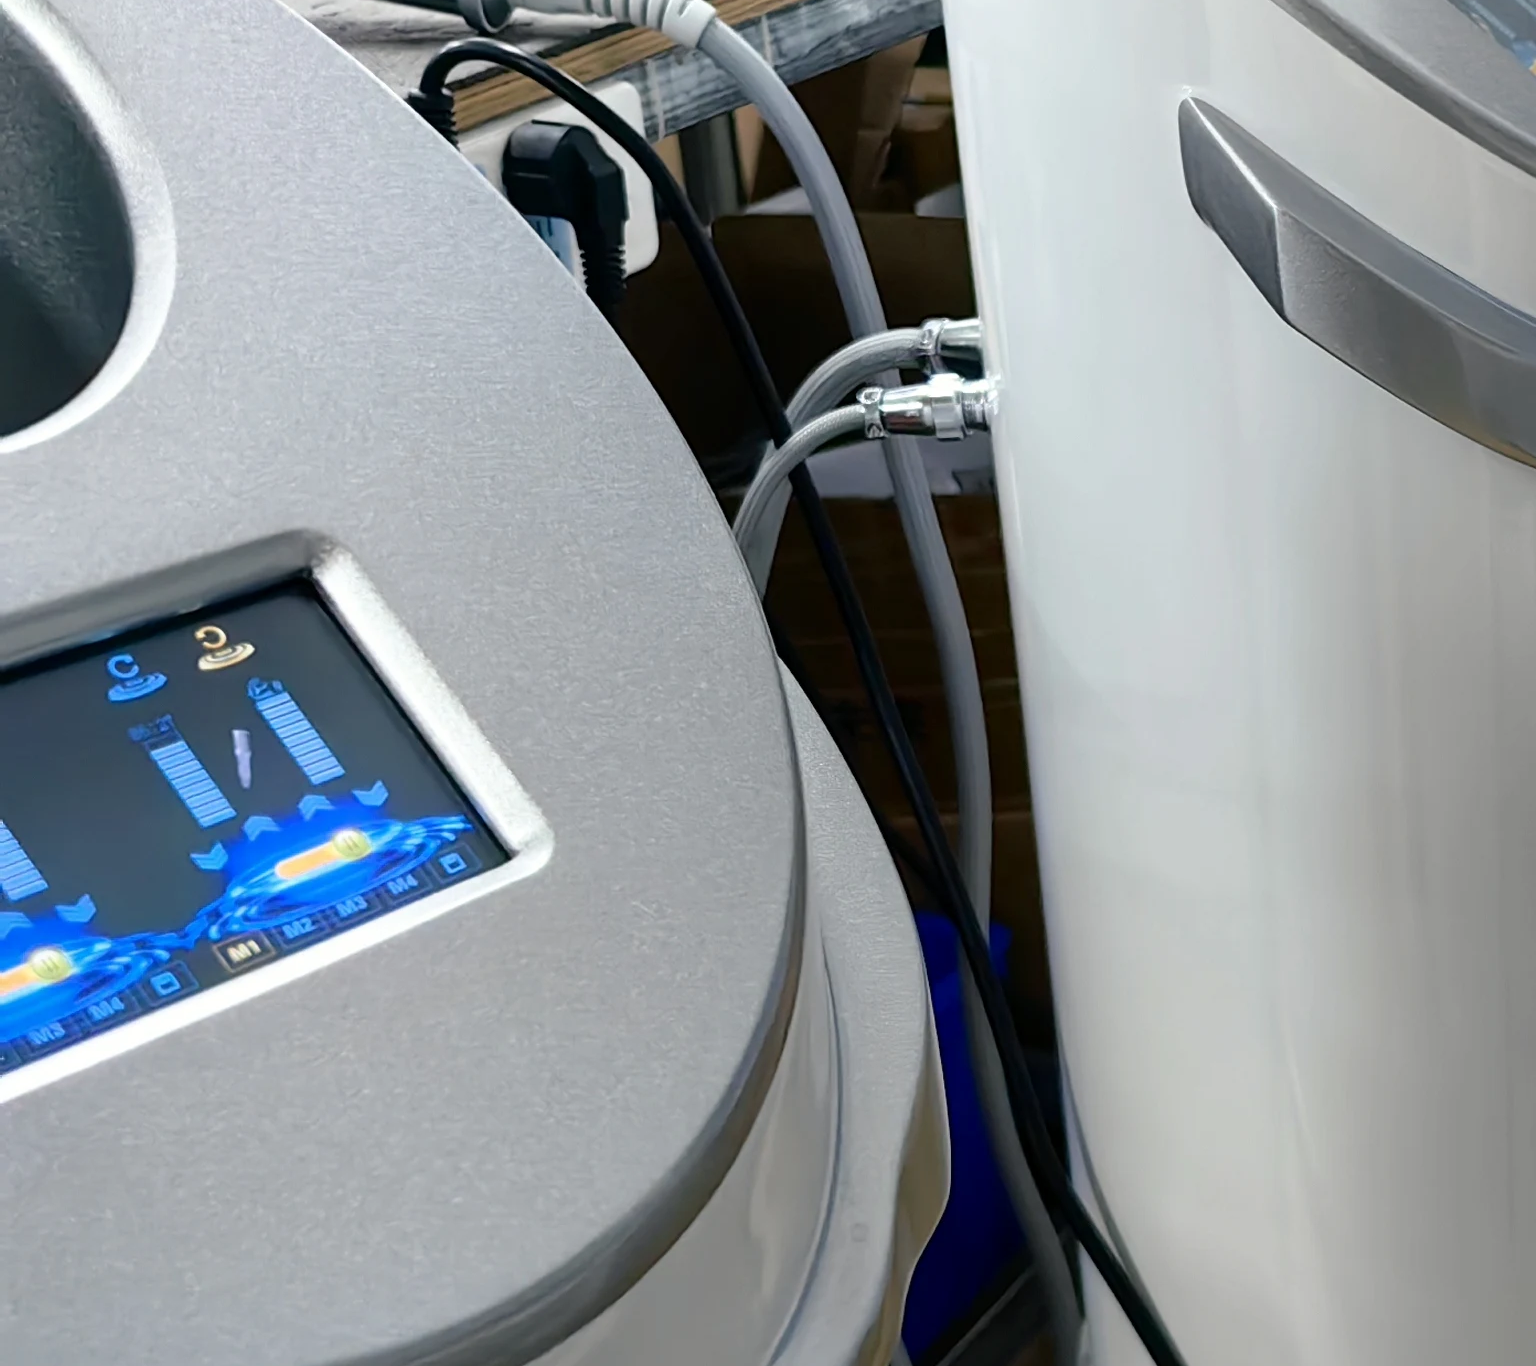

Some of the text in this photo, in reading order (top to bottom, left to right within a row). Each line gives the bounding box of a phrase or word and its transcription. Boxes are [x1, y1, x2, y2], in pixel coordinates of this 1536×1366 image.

[227, 875, 419, 964] M1 M2 M3 M4
